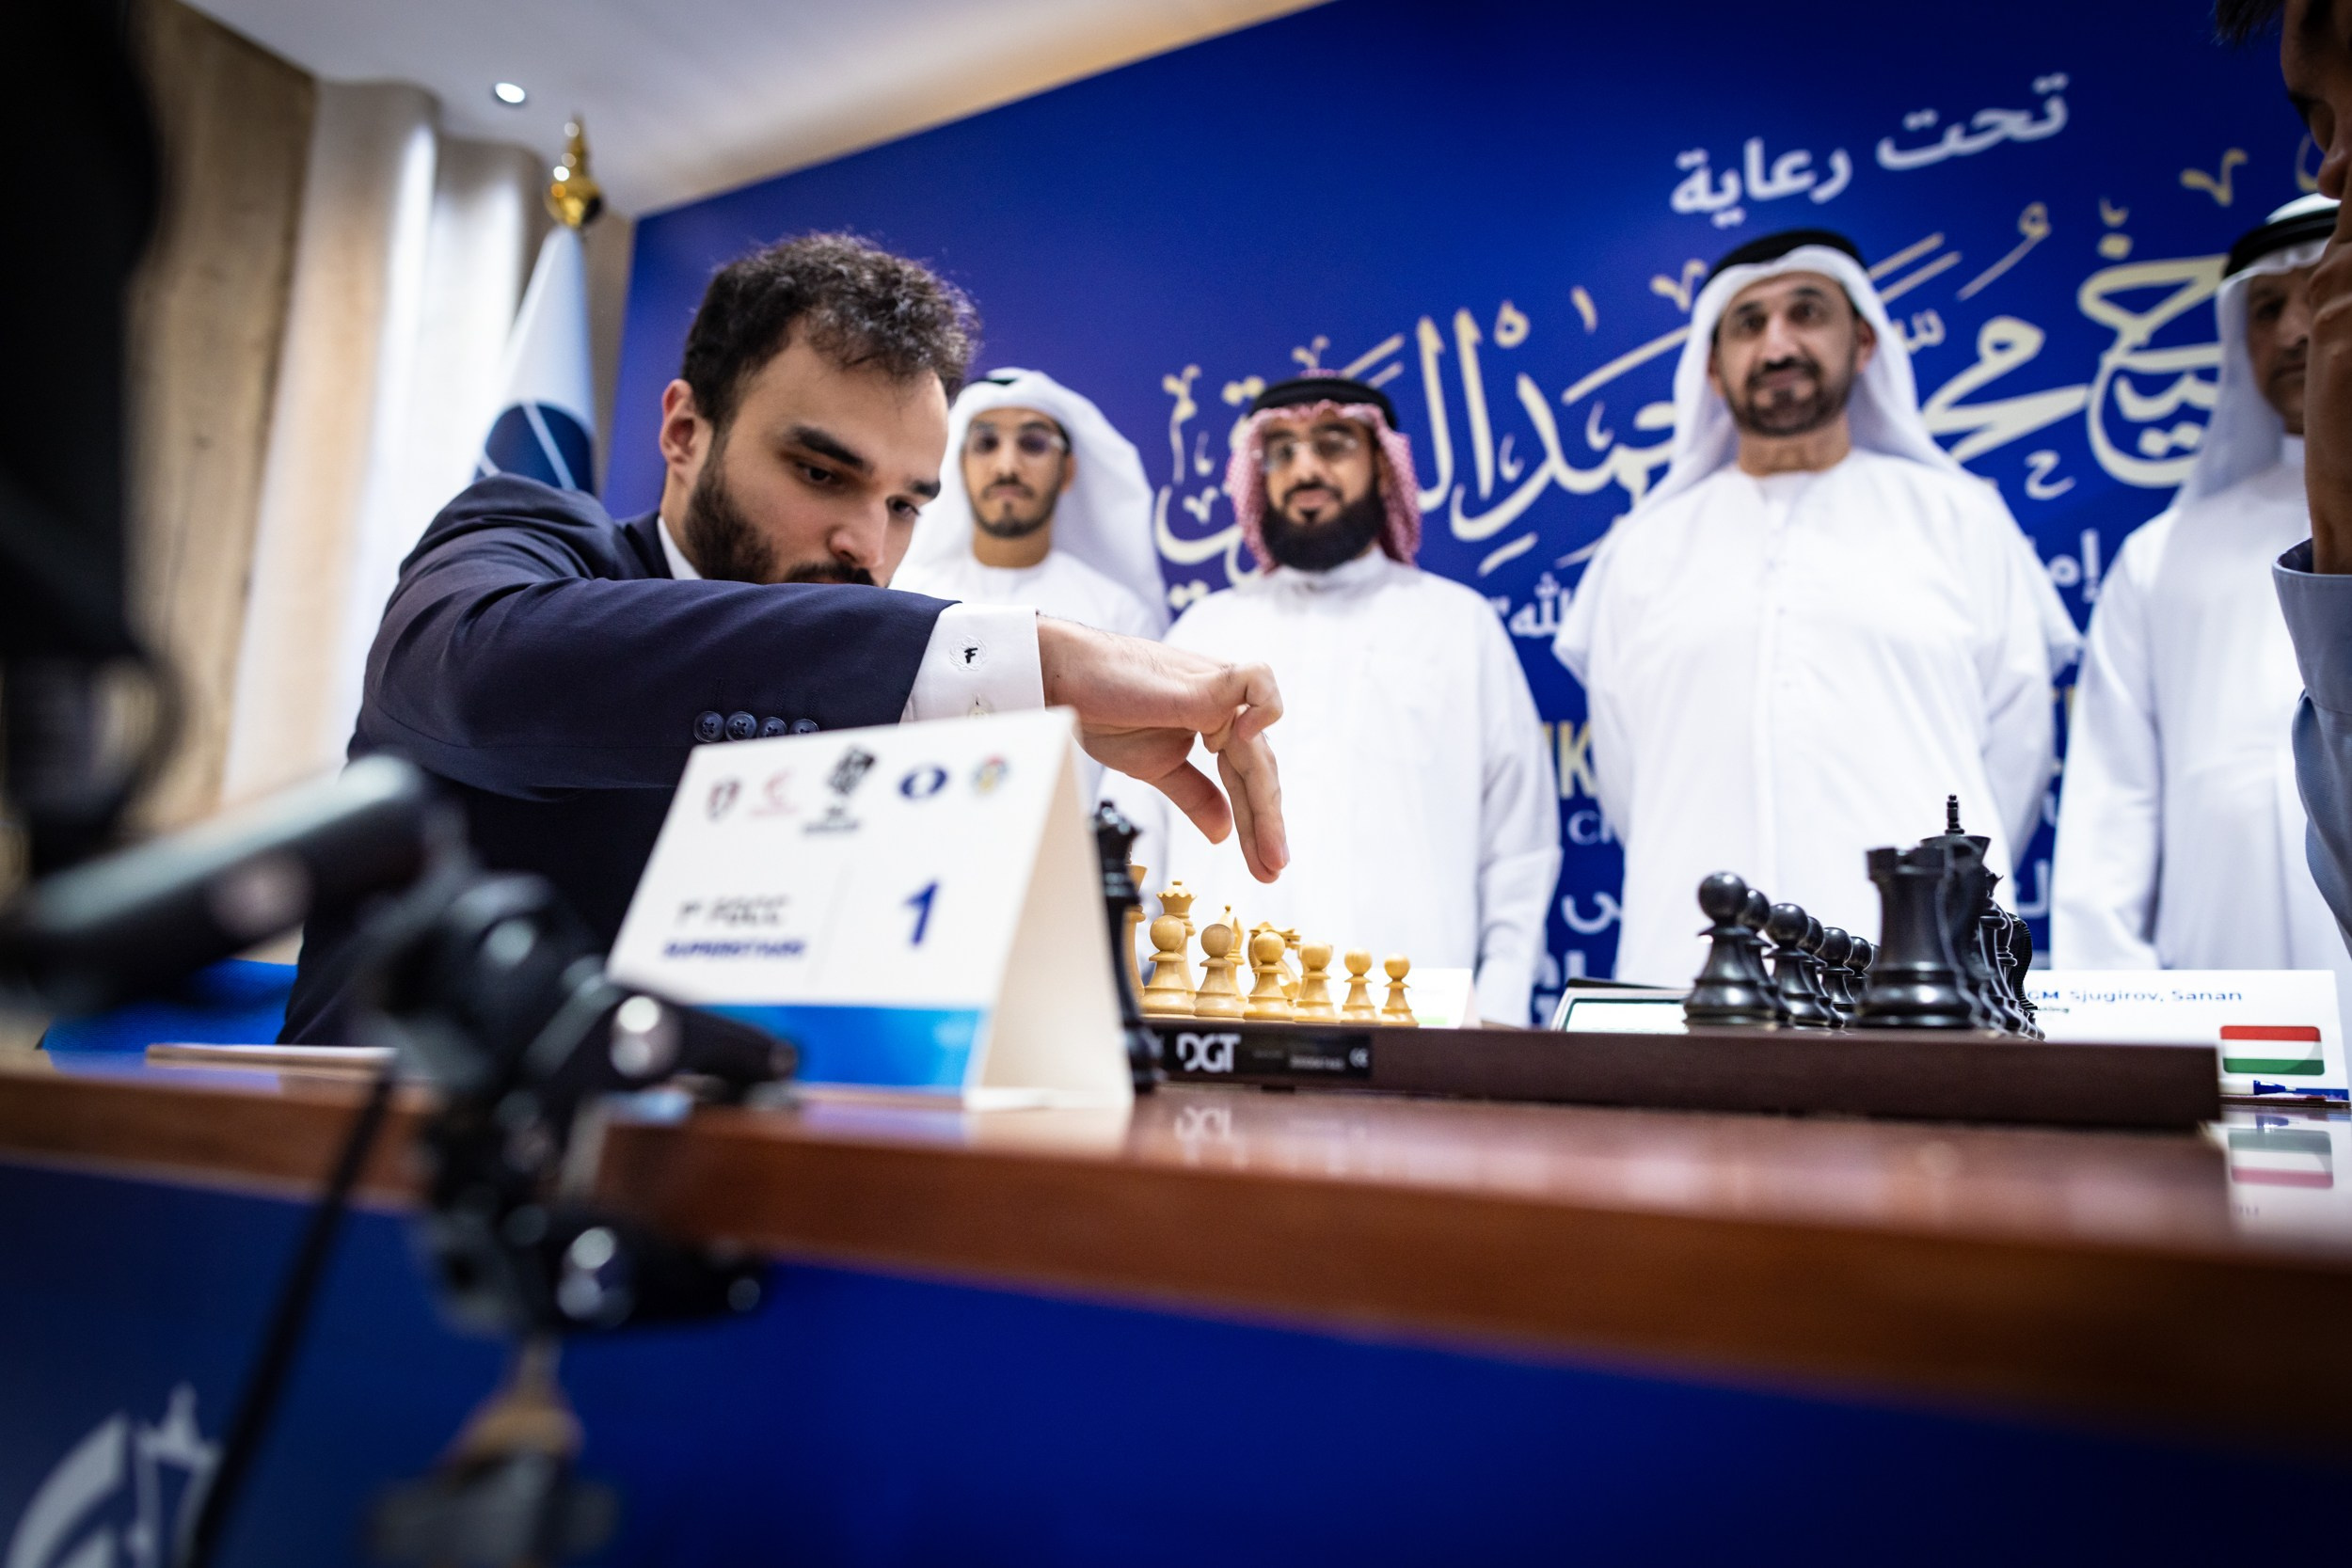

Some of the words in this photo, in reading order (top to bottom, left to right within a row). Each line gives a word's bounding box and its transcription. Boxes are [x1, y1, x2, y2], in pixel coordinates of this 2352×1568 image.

[1876, 72, 2070, 170] تحت
[1670, 135, 1853, 230] رعاية
[964, 647, 978, 664] F
[902, 882, 940, 946] 1
[2070, 990, 2164, 1003] Sjugirov,
[2172, 990, 2242, 1002] Sanan
[1177, 1033, 1241, 1073] DGT
